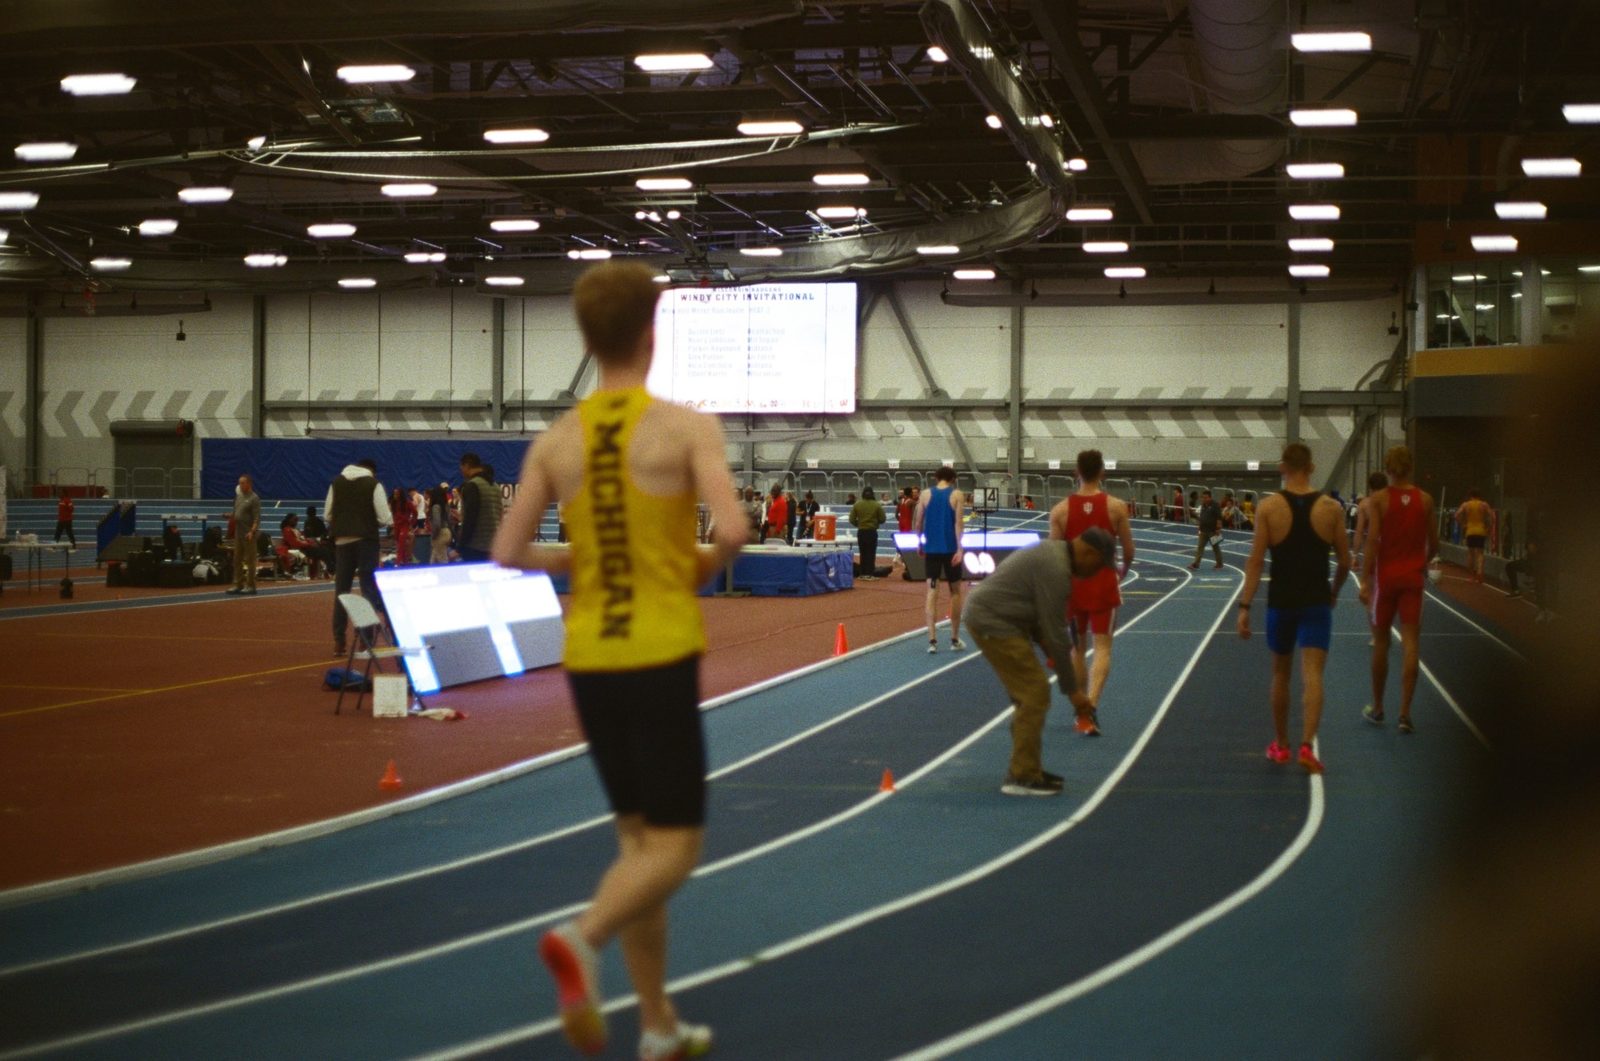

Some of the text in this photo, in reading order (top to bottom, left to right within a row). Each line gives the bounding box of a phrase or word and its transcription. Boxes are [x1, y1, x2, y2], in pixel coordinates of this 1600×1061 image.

[680, 293, 814, 301] WINDY CITY INVITATIONAL
[987, 488, 996, 502] 4
[592, 422, 634, 639] MICHIGAN
